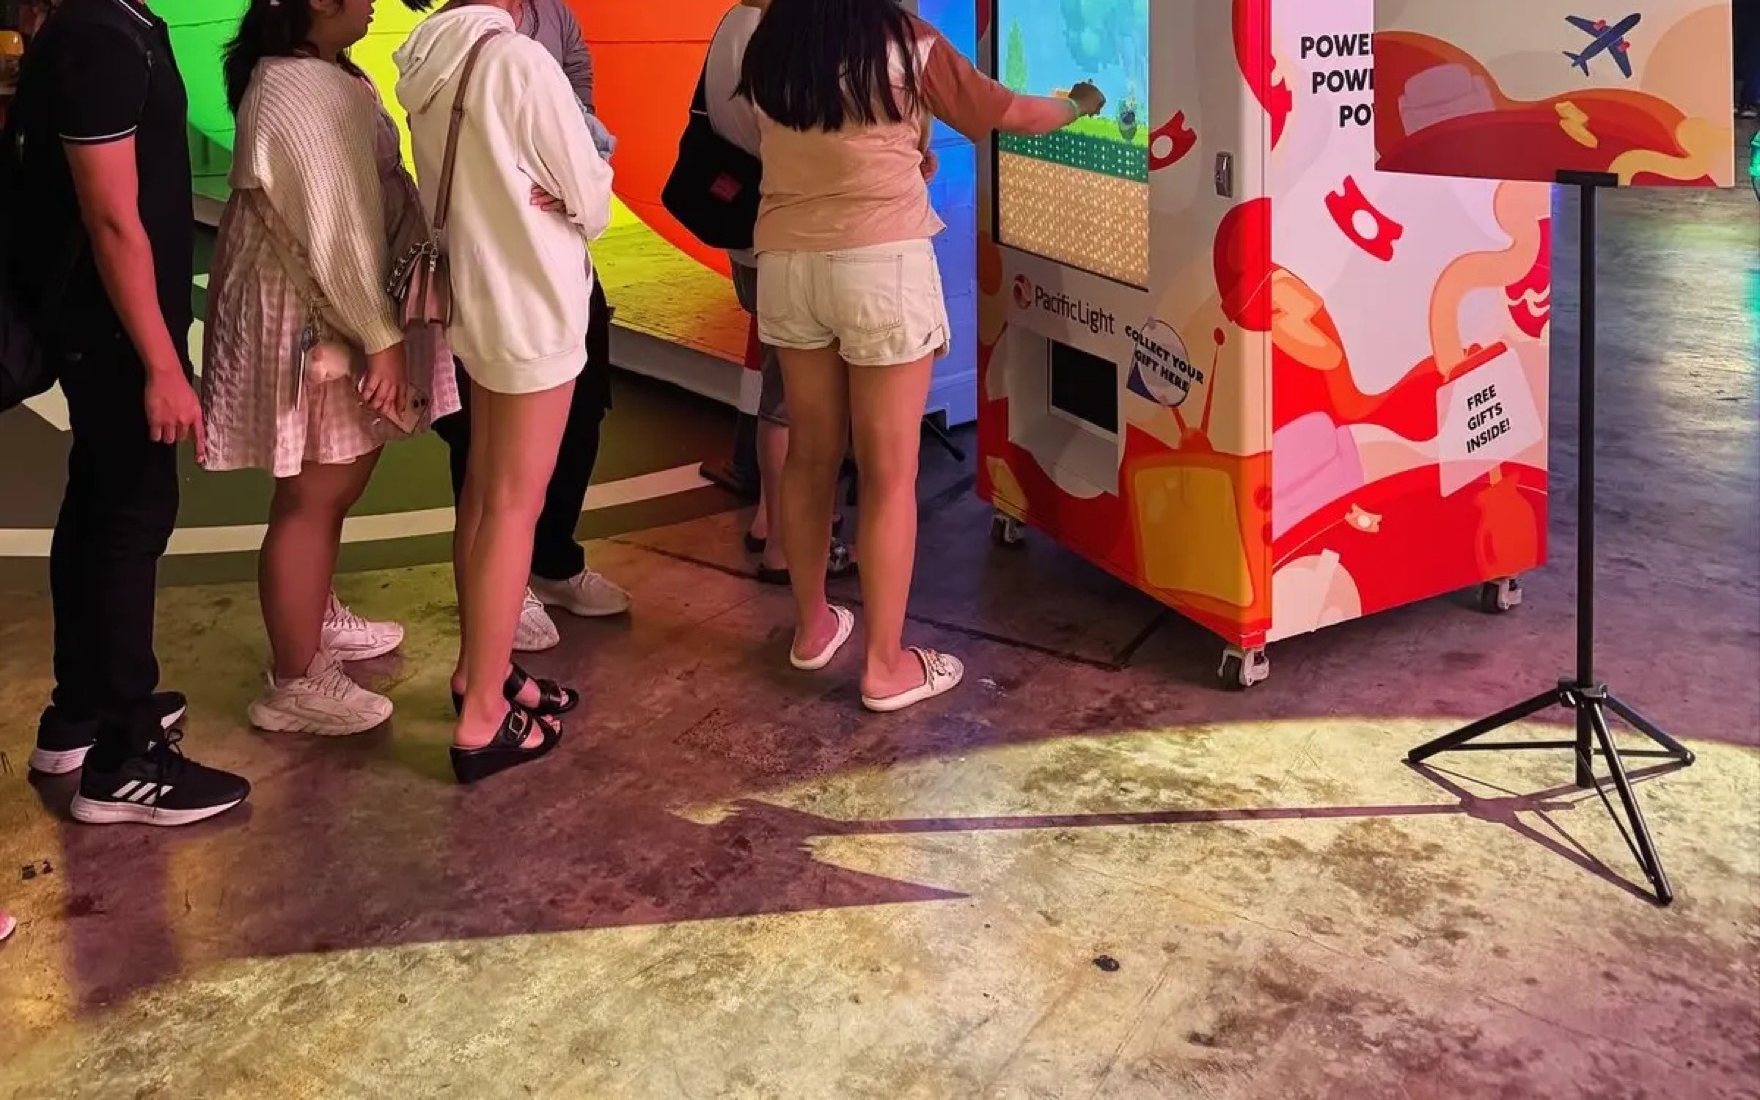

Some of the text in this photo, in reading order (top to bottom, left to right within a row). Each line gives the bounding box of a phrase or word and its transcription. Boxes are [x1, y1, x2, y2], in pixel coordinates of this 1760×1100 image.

[1339, 103, 1374, 128] PO
[1035, 285, 1115, 335] PacificLight
[1125, 325, 1203, 385] COLLECT YOUR
[1134, 350, 1189, 393] GIFT HERE
[1466, 384, 1497, 411] FREE
[1467, 402, 1503, 431] GIFTS
[1466, 417, 1511, 453] INSIDE!
